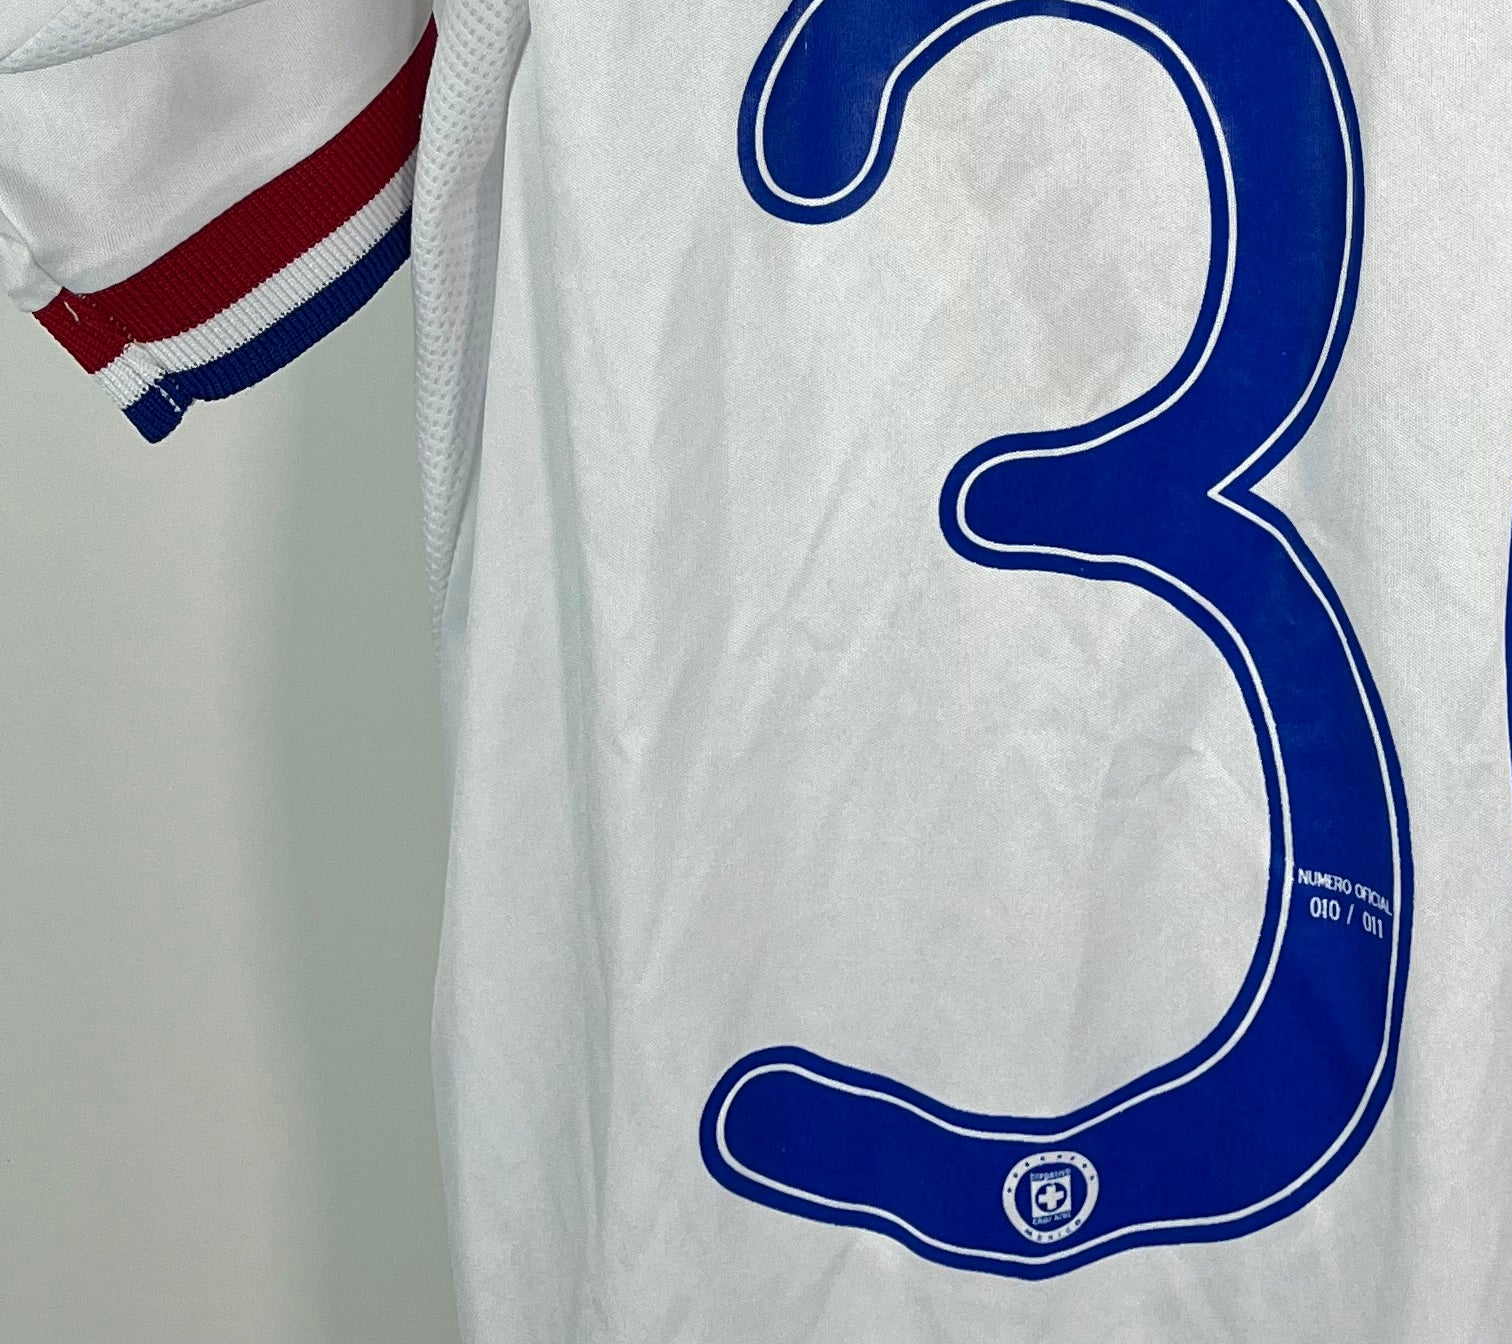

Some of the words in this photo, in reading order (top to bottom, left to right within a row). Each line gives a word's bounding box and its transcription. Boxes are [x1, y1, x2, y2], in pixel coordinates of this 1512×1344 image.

[1297, 867, 1352, 895] NUMERO
[1354, 883, 1393, 917] OFICIAL
[1309, 896, 1341, 921] 010
[1362, 911, 1384, 939] 011
